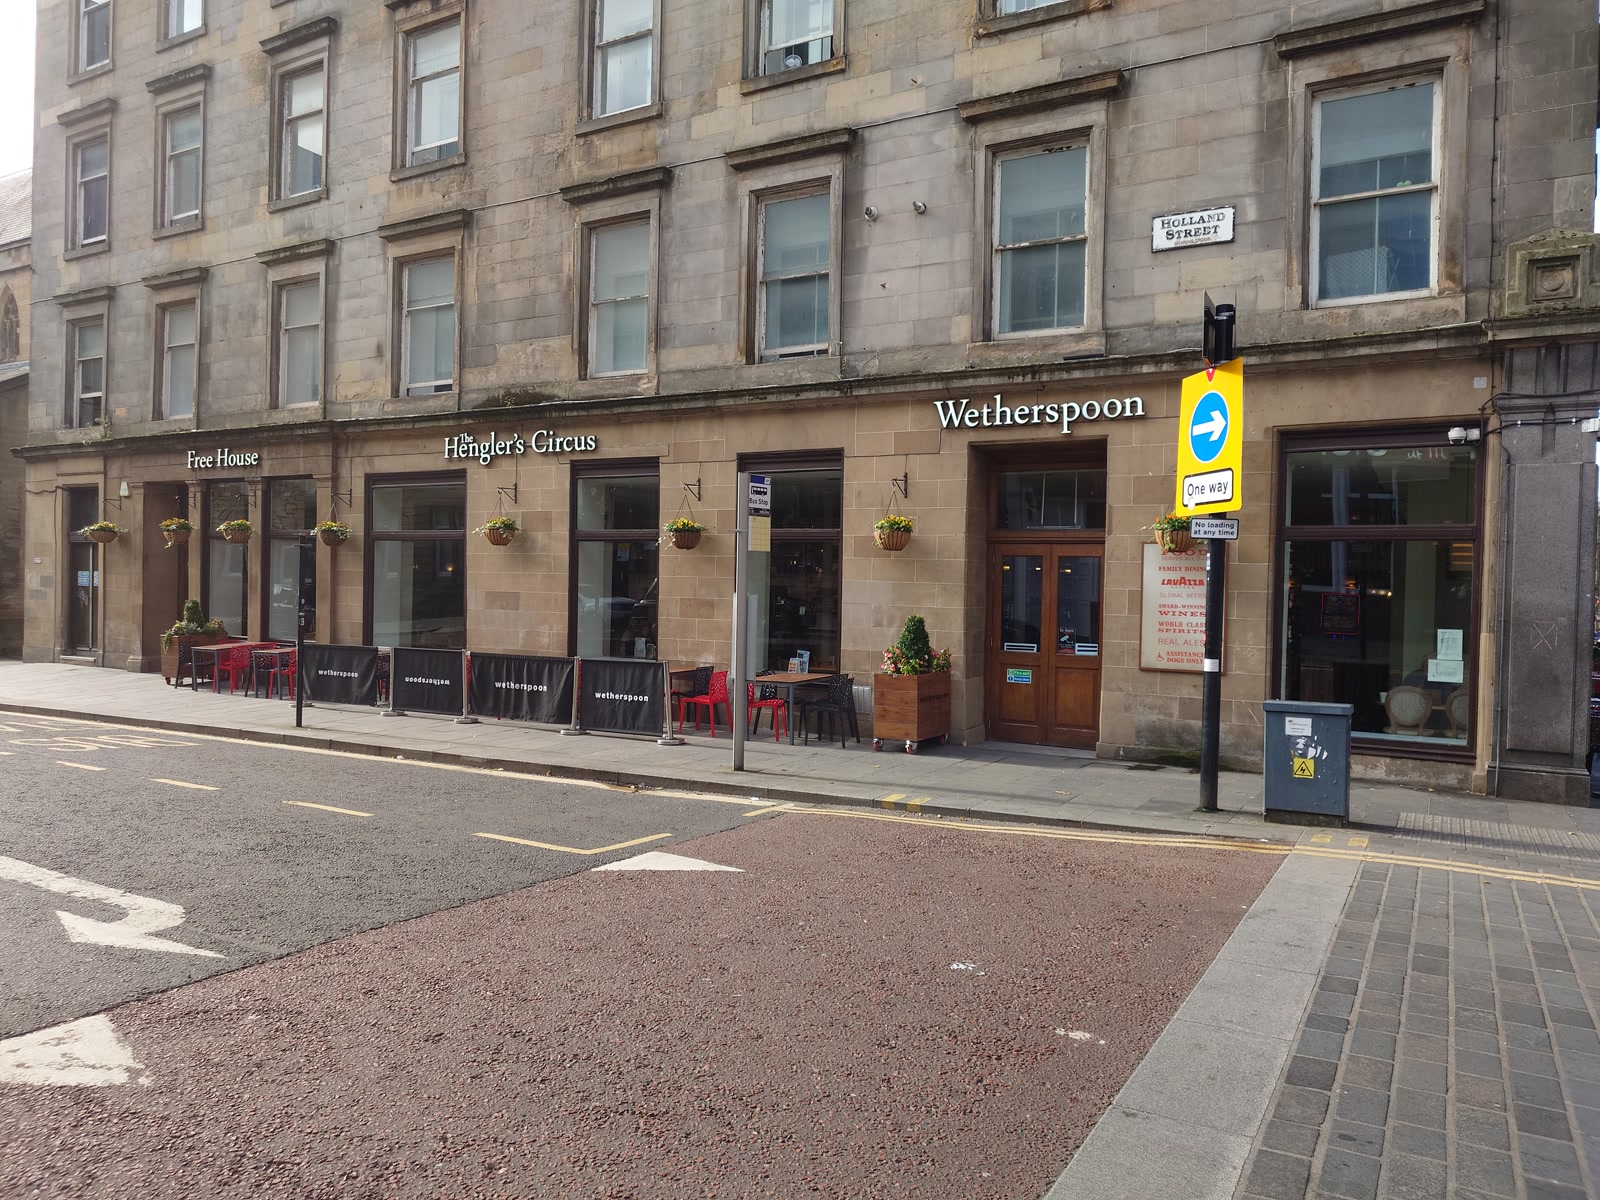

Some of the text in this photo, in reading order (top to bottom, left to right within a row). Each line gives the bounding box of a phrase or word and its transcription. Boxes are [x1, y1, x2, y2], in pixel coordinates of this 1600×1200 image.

[1160, 212, 1226, 229] HOLLAND
[1166, 224, 1220, 241] STREET
[933, 394, 1146, 435] Wetherspoon
[459, 433, 474, 445] The
[444, 430, 597, 466] Hengler's Circus
[187, 448, 260, 469] Free House
[1187, 480, 1229, 497] One way
[758, 498, 769, 506] Stop
[1195, 521, 1235, 531] No loading
[1203, 530, 1215, 538] any
[1217, 528, 1235, 537] time
[1161, 576, 1205, 587] LAVAZZA
[1158, 638, 1205, 647] REAL ALES
[318, 669, 359, 678] wetherspoon
[405, 676, 450, 686] wetherspoon
[495, 680, 548, 692] wetherspoon
[595, 691, 649, 703] wetherspoon
